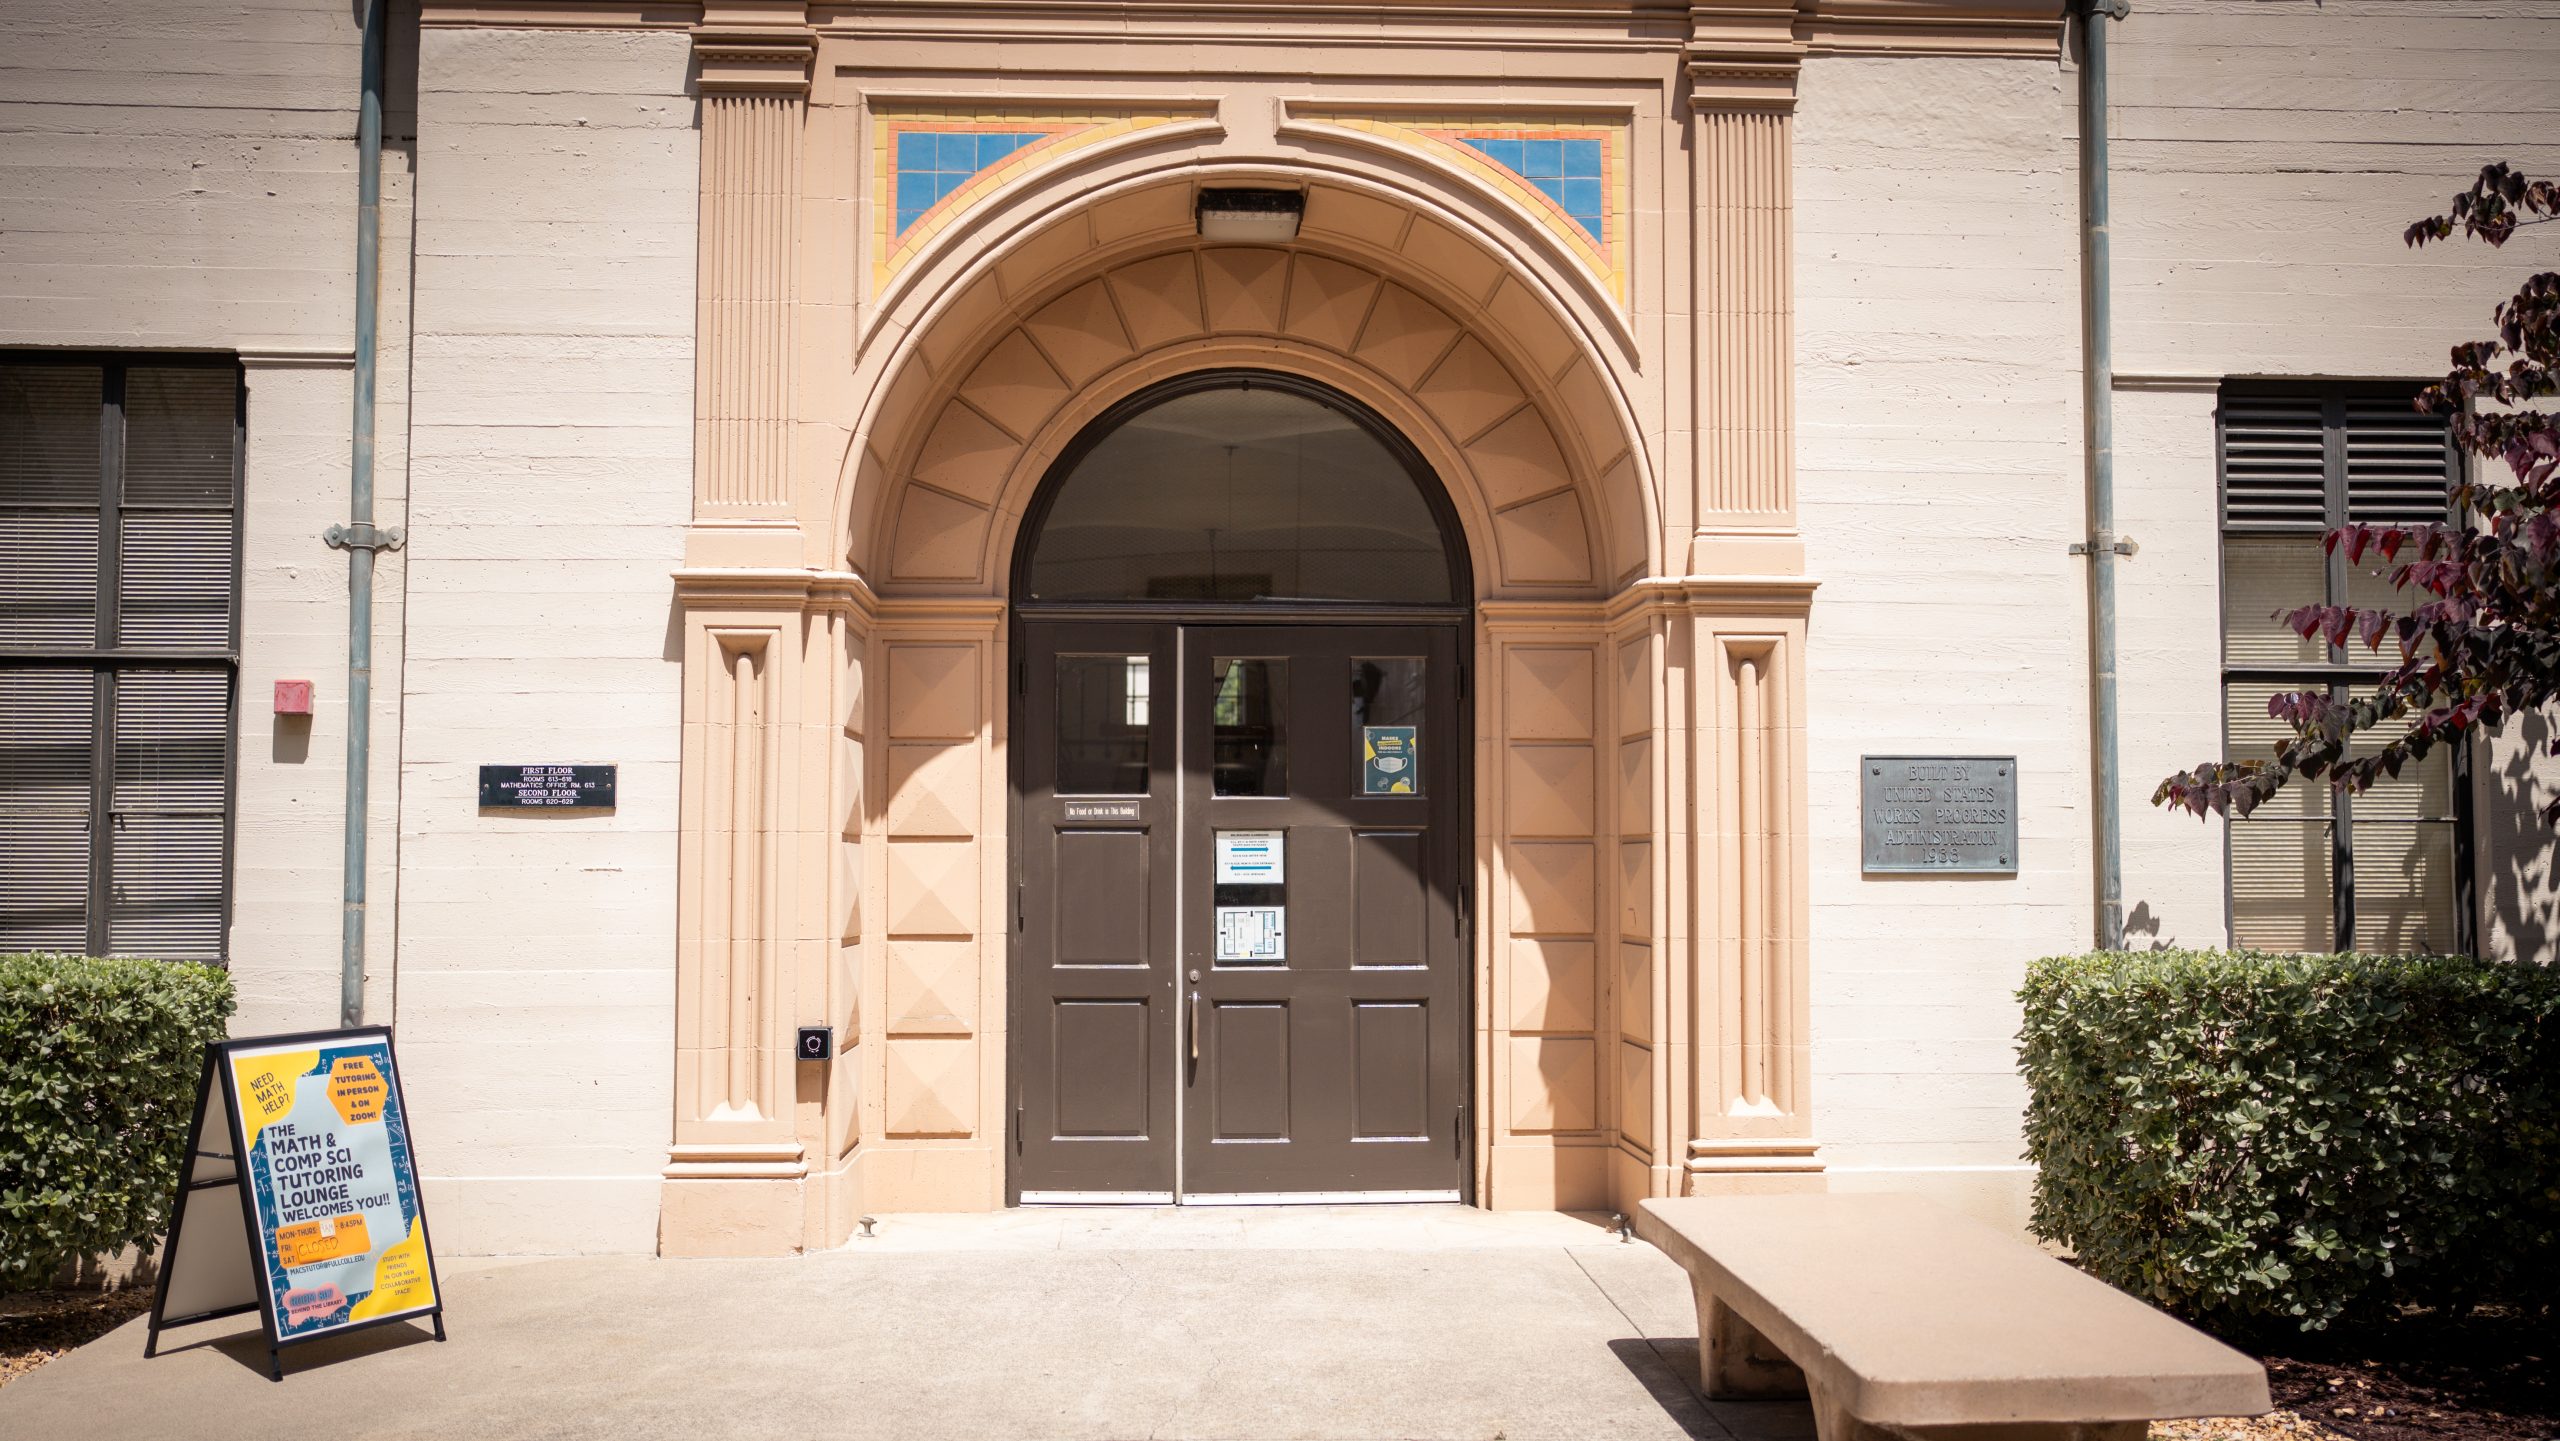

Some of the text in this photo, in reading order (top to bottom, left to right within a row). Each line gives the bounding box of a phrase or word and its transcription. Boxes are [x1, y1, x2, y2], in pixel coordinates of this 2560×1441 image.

[1908, 766, 1971, 781] BUILT BY
[1884, 787, 1994, 802] UNITED STATES
[1874, 809, 2006, 824] WORKS PROGRESS
[1885, 829, 1998, 846] ADMINISTRATION
[343, 1061, 364, 1070] FREE
[250, 1072, 274, 1092] NEED
[335, 1072, 376, 1084] TUTORING
[256, 1082, 285, 1104] MATH
[347, 1085, 379, 1096] PERSON
[263, 1093, 290, 1115] HELP?
[350, 1112, 376, 1121] ZOOM!
[269, 1124, 295, 1138] THE
[272, 1132, 336, 1156] MATH &
[274, 1148, 351, 1172] COMP SCI
[278, 1164, 363, 1190] TUTORING
[281, 1184, 349, 1209] LOUNGE
[283, 1193, 390, 1222] WELCOMES YOU!!
[340, 1219, 362, 1229] 8:45PM
[299, 1237, 338, 1256] CLOSED
[290, 1255, 365, 1275] MACSTUTOR@FULLCOLL.EDU
[386, 1263, 407, 1271] FRIENDS
[381, 1277, 421, 1290] COLLABORATIVE
[291, 1306, 310, 1314] BEHIND
[323, 1299, 343, 1308] LIBRARY
